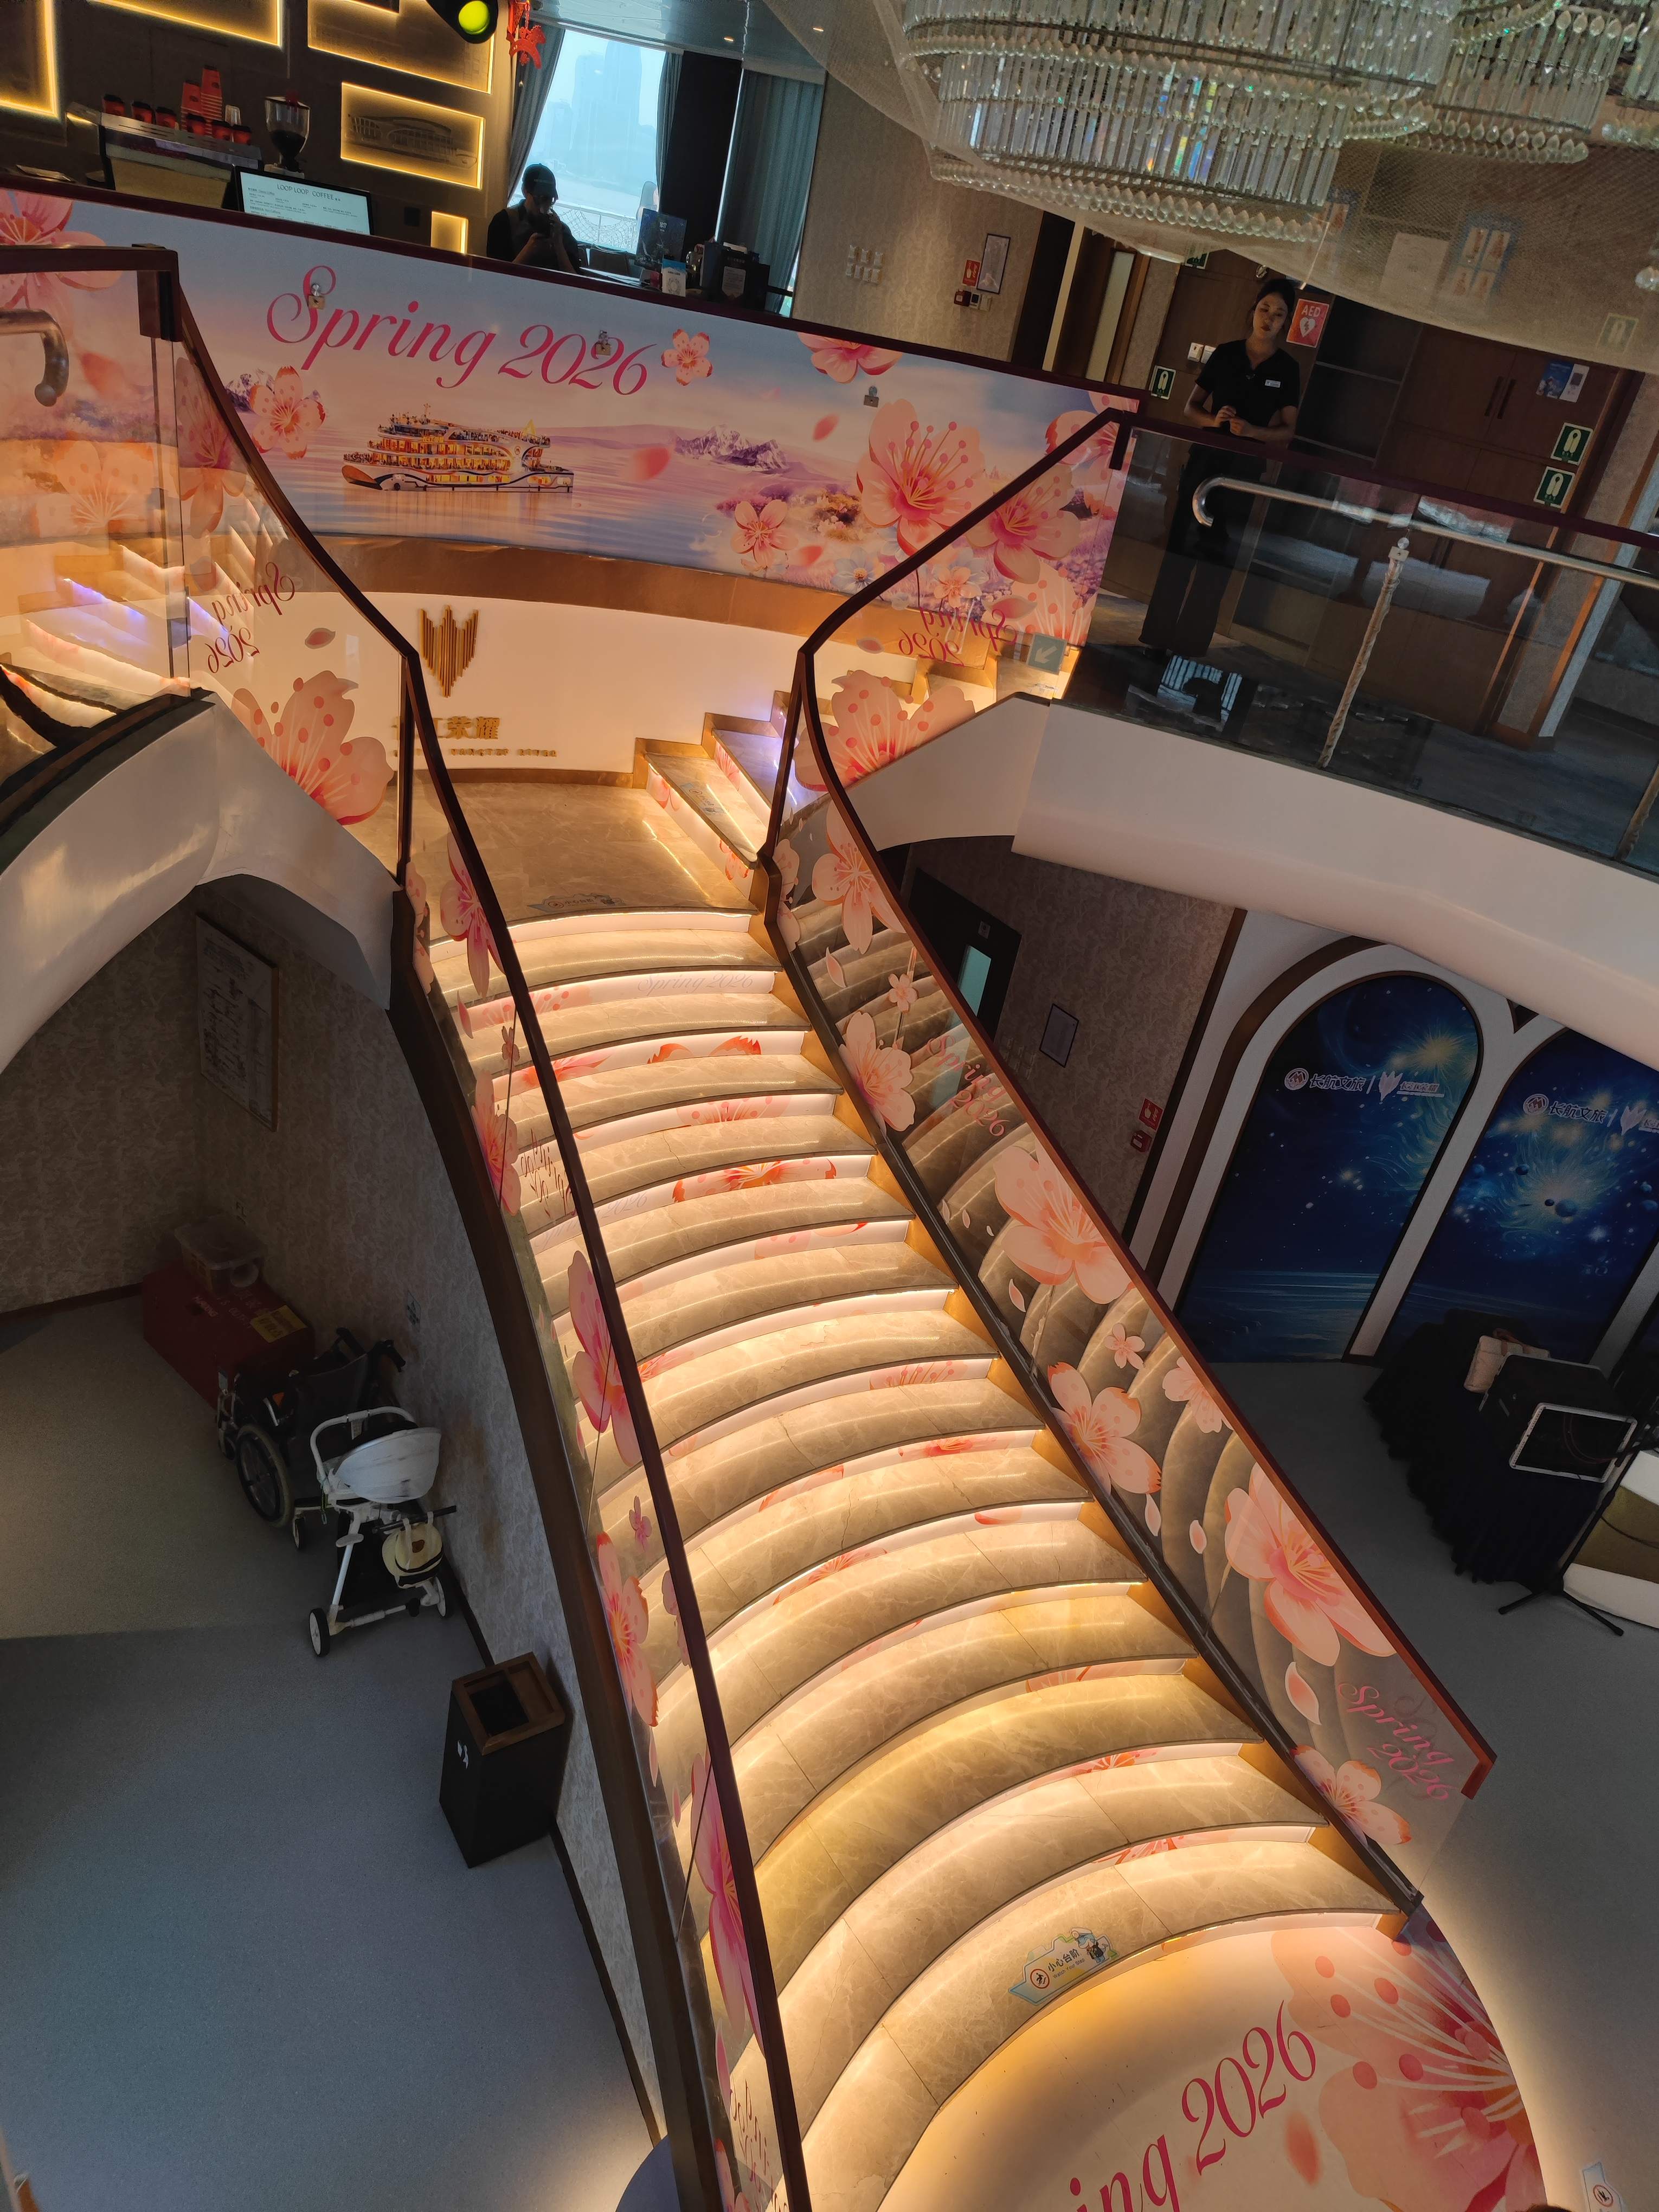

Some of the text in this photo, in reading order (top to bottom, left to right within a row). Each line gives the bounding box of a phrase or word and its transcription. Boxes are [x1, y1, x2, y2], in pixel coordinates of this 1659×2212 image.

[312, 191, 335, 200] COFFEE
[1301, 305, 1321, 317] AED
[266, 265, 658, 395] Spring 2026
[518, 749, 557, 757] RIVER
[638, 973, 753, 996] Spring 2026
[927, 1035, 1007, 1103] Spring
[1310, 1073, 1366, 1091] 长航文旅
[950, 1090, 1011, 1136] 2026
[1549, 1101, 1608, 1123] 长航文旅
[601, 1193, 647, 1219] 2026
[1338, 1683, 1455, 1766] Spring
[1366, 1744, 1458, 1801] 2026
[1047, 1948, 1081, 1972] 小心台阶
[1052, 1968, 1066, 1979] Watch
[1181, 1999, 1316, 2176] 2026
